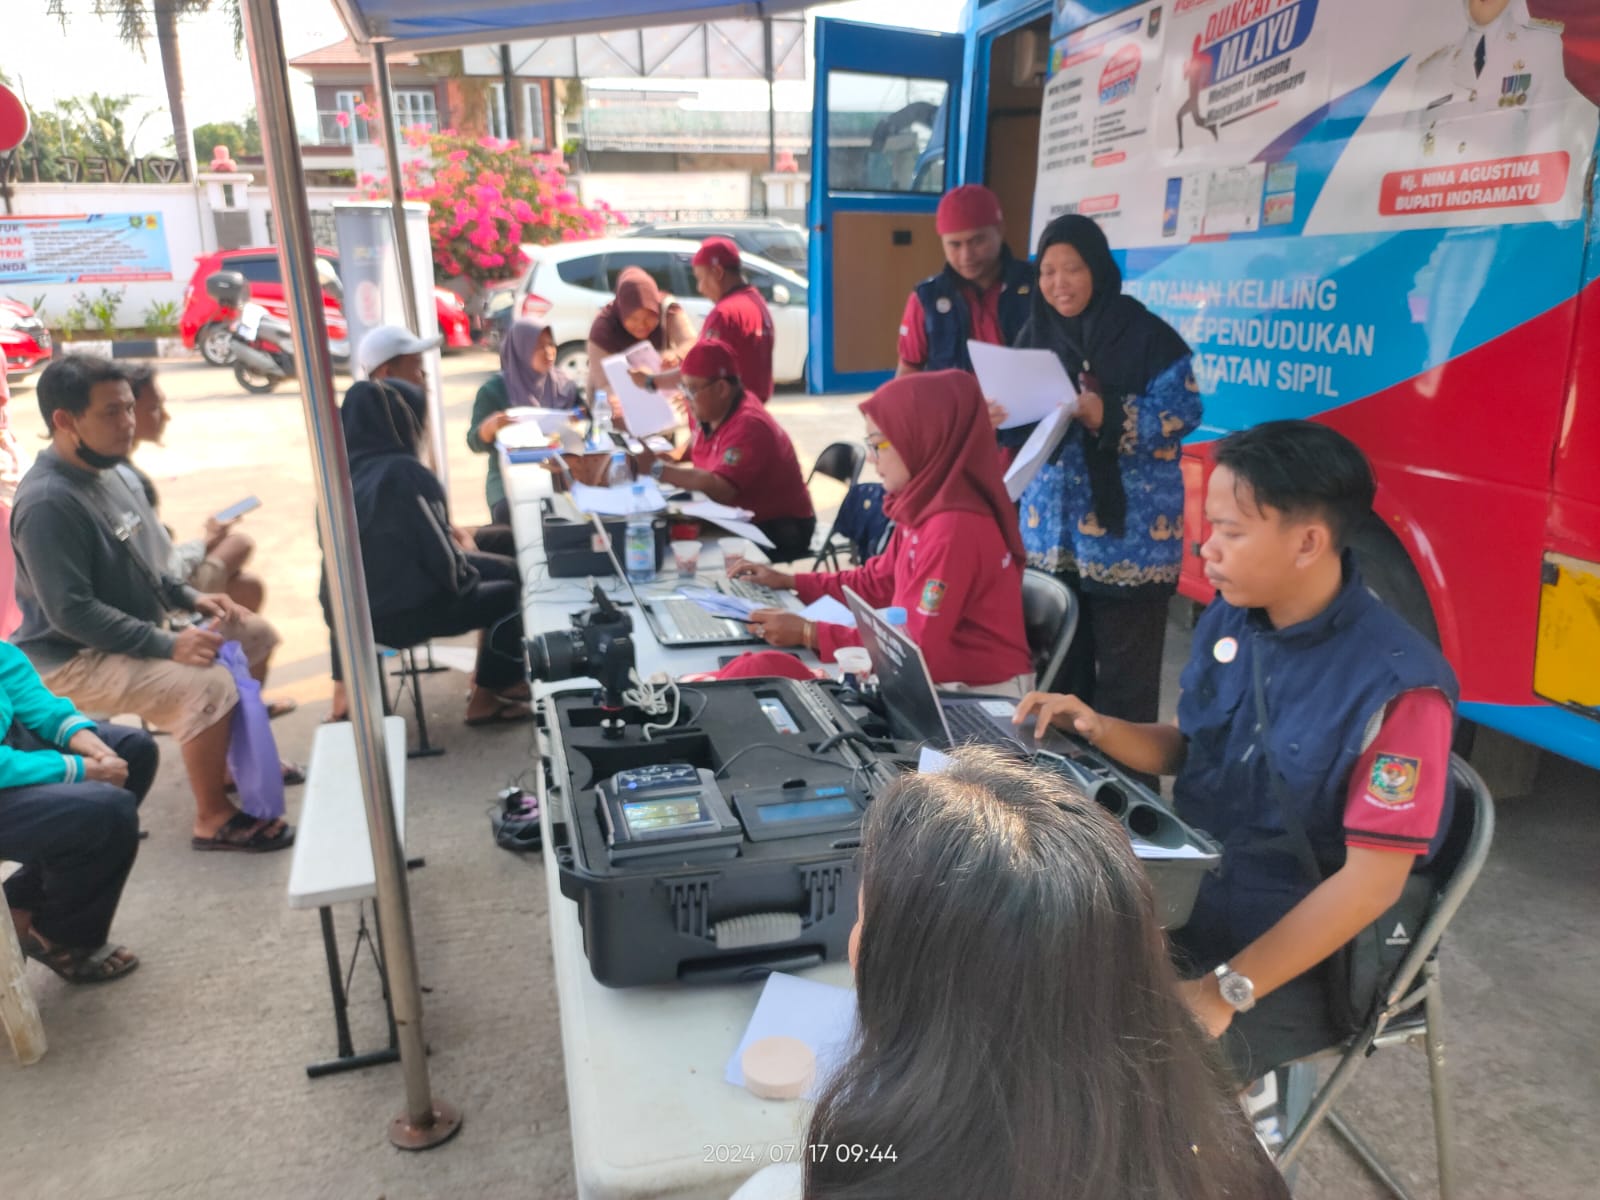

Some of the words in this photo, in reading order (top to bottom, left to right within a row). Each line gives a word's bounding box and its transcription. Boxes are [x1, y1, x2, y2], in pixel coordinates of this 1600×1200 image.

[1204, 0, 1300, 44] DUKCA
[1216, 4, 1300, 81] MLAYU
[1421, 170, 1456, 188] NINA
[1458, 160, 1539, 184] AGUSTINA
[1395, 191, 1442, 211] BUPATI
[1446, 184, 1540, 206] INDRAMAYU
[1226, 279, 1337, 311] KELILING
[1179, 315, 1375, 356] KEPENDUDUKAN
[1192, 352, 1271, 388] ATATAN
[1276, 361, 1339, 397] SIPIL
